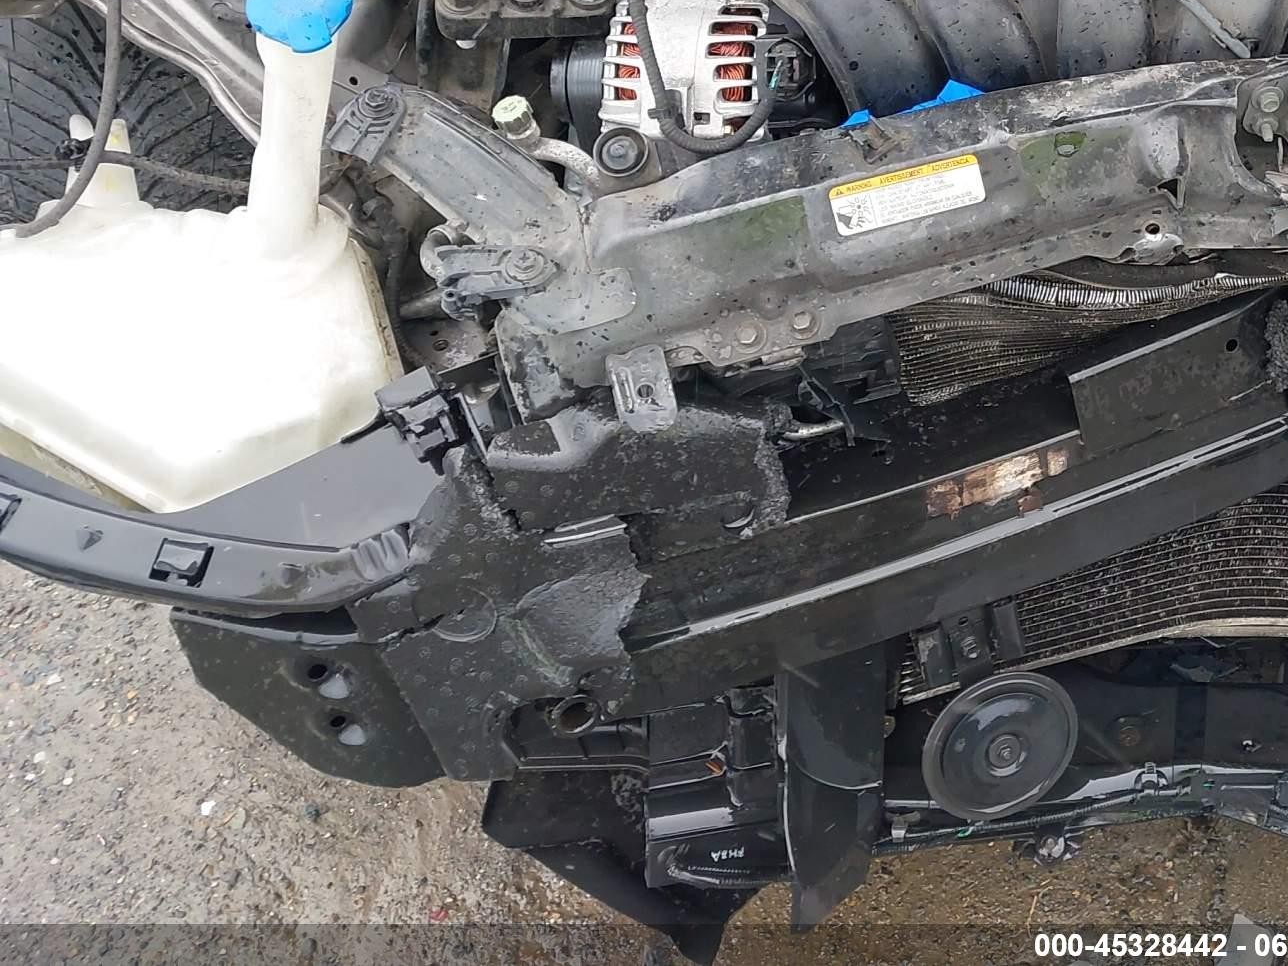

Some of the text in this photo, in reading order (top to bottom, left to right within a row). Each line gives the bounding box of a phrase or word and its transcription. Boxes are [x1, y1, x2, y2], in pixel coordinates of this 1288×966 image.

[846, 156, 970, 194] WARNING AVERTISSEMENT ADVERTENCIA
